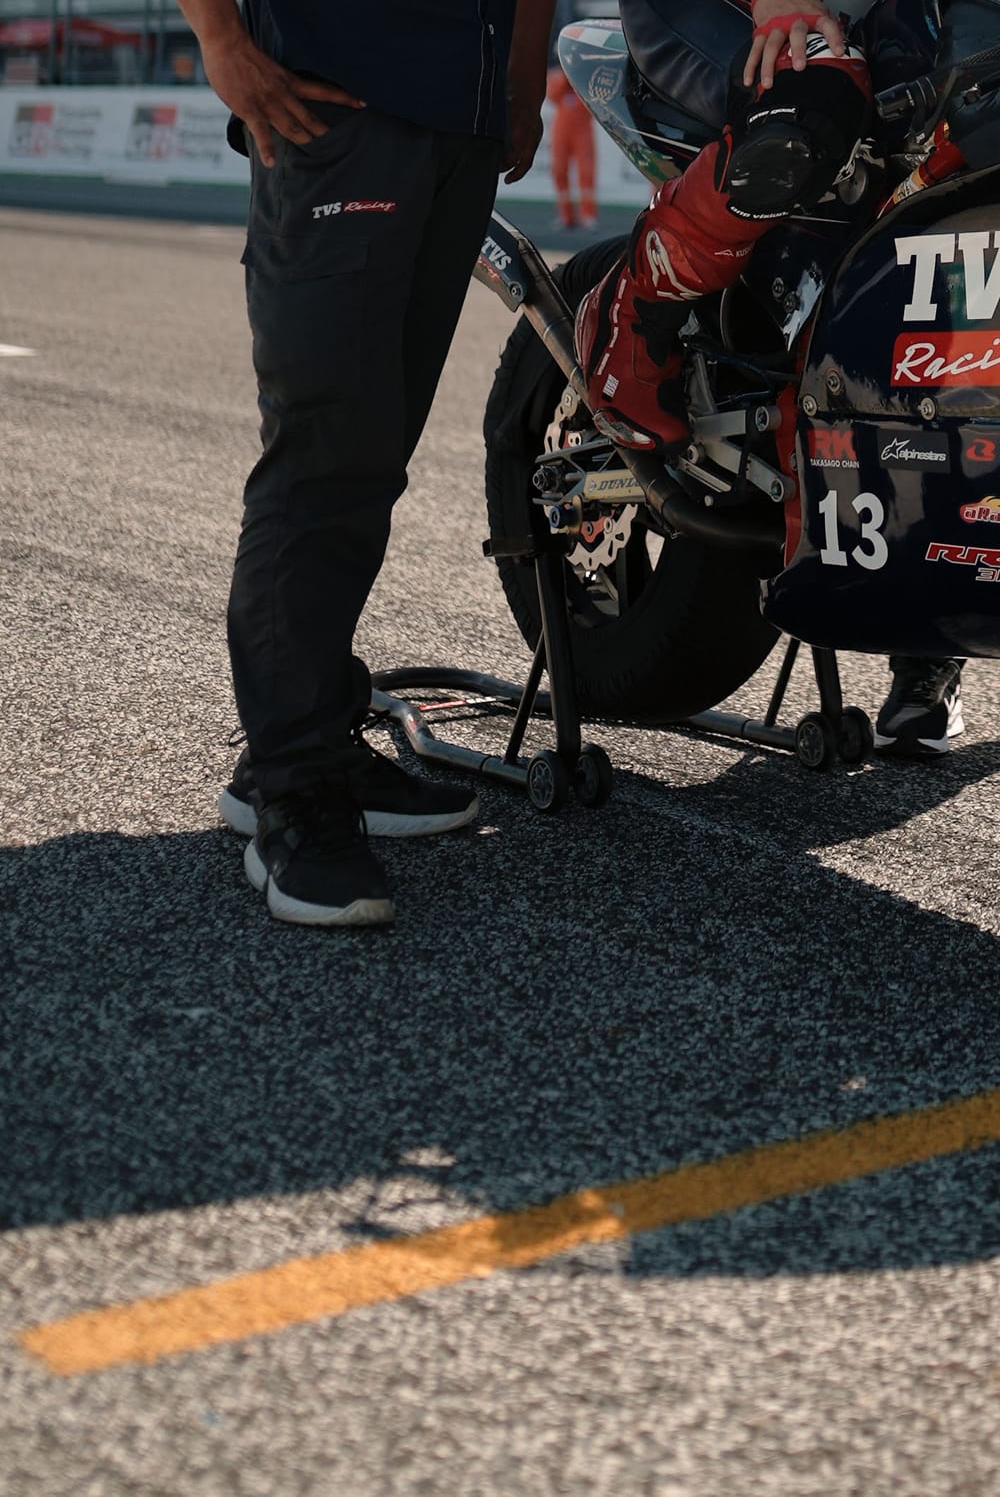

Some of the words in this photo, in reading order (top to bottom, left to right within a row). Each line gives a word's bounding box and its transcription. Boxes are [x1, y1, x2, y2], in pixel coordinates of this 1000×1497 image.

[312, 202, 342, 219] TVS
[481, 236, 512, 271] TVS
[807, 428, 858, 461] RK
[898, 448, 947, 463] alpinestars
[841, 459, 860, 470] CHAIN
[818, 489, 889, 571] 13
